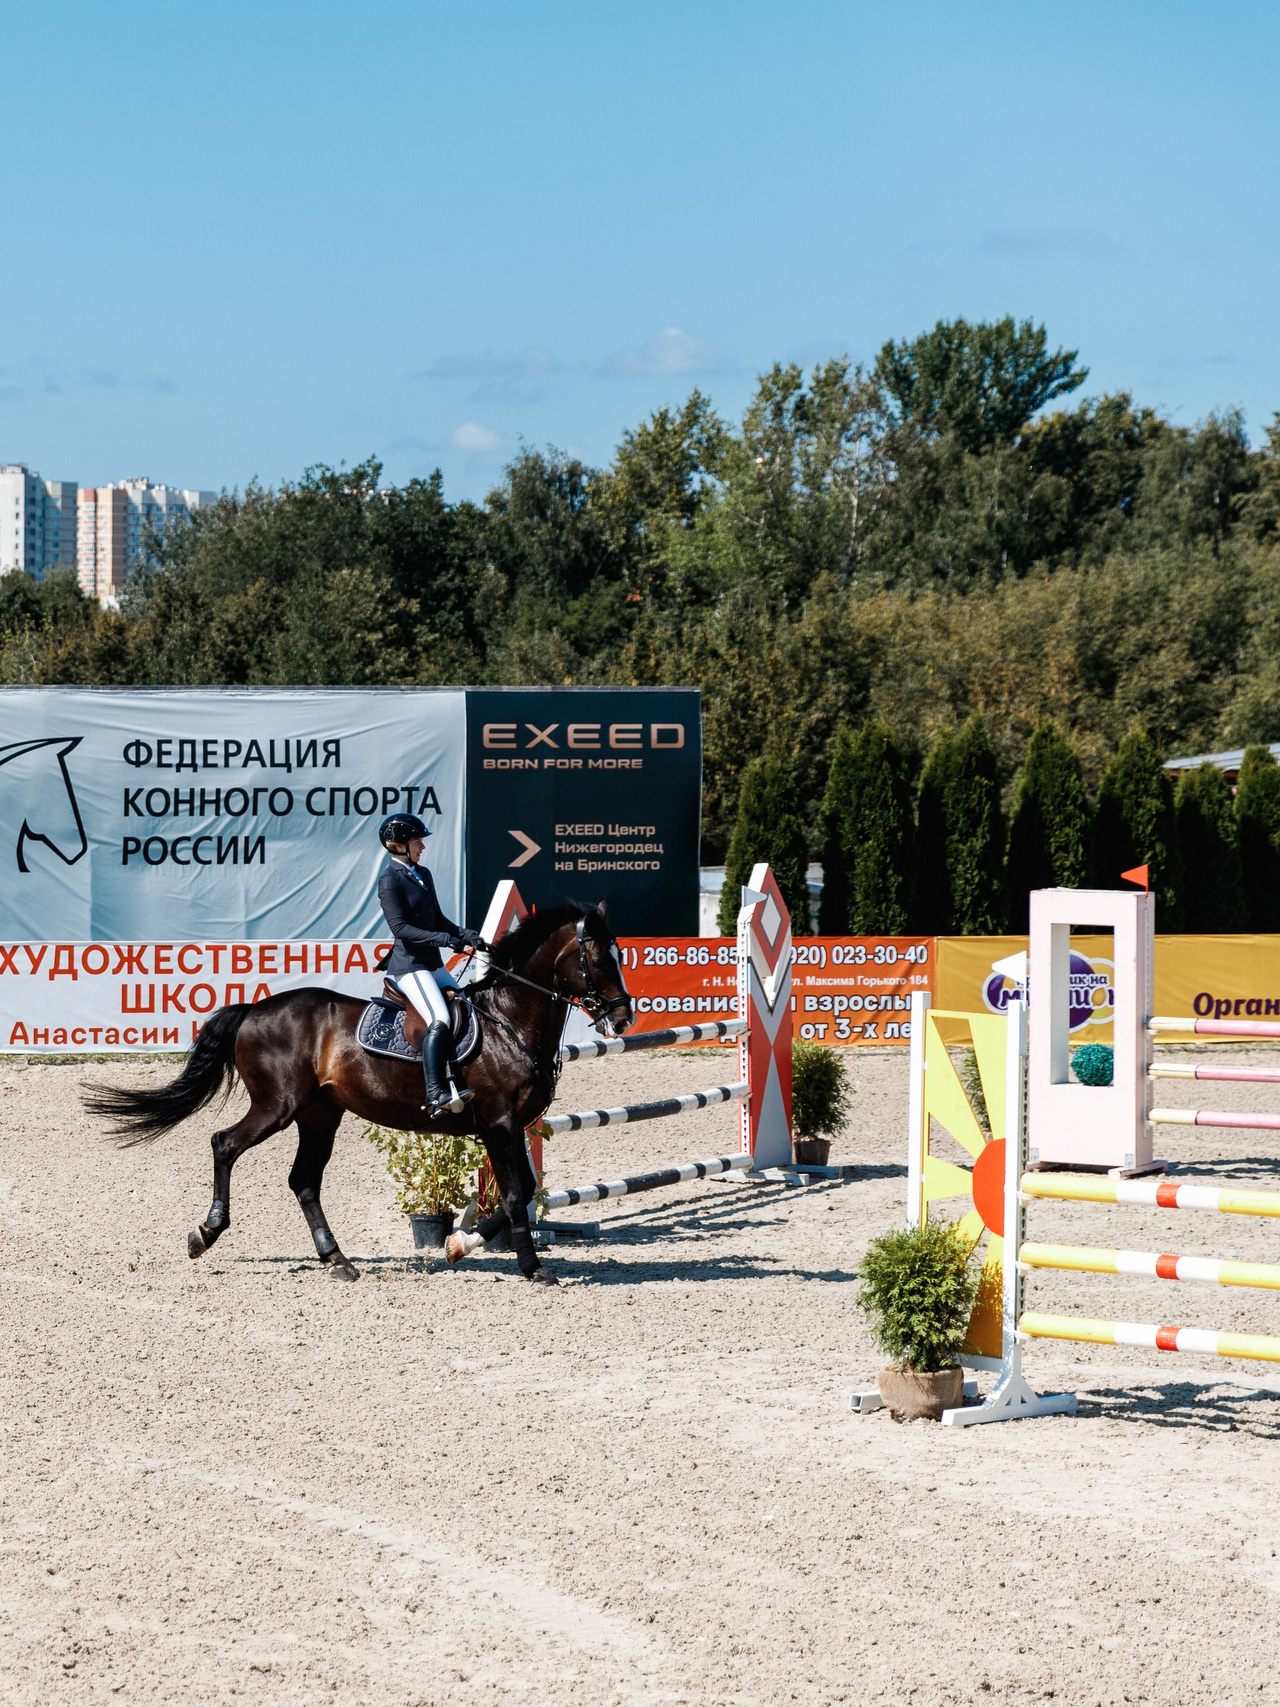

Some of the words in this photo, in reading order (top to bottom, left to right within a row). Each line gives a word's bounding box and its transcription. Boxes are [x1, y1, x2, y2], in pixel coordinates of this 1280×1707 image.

[483, 723, 685, 749] EXEED
[122, 739, 342, 773] ФЕДЕРАЦИЯ
[483, 758, 539, 769] BORN
[543, 758, 583, 769] FOR
[588, 758, 644, 769] MORE
[122, 786, 294, 817] КОННОГО
[305, 785, 443, 817] СПОРТА
[554, 824, 605, 836] EXEED
[608, 824, 656, 838] Центр
[121, 835, 267, 866] РОССИИ
[554, 842, 665, 855] Нижегородец
[554, 861, 574, 871] на
[577, 859, 661, 873] Бринского
[643, 946, 738, 966] 266-86-85
[831, 945, 928, 965] 023-30-40
[806, 976, 854, 987] Максима
[857, 976, 907, 988] Горького
[910, 975, 929, 986] 184
[121, 982, 273, 1014] ШКОЛА
[804, 995, 911, 1016] взрослы
[9, 1021, 180, 1046] Анастасии
[800, 1022, 829, 1040] от
[834, 1018, 879, 1040] 3-х
[883, 1022, 911, 1040] ле
